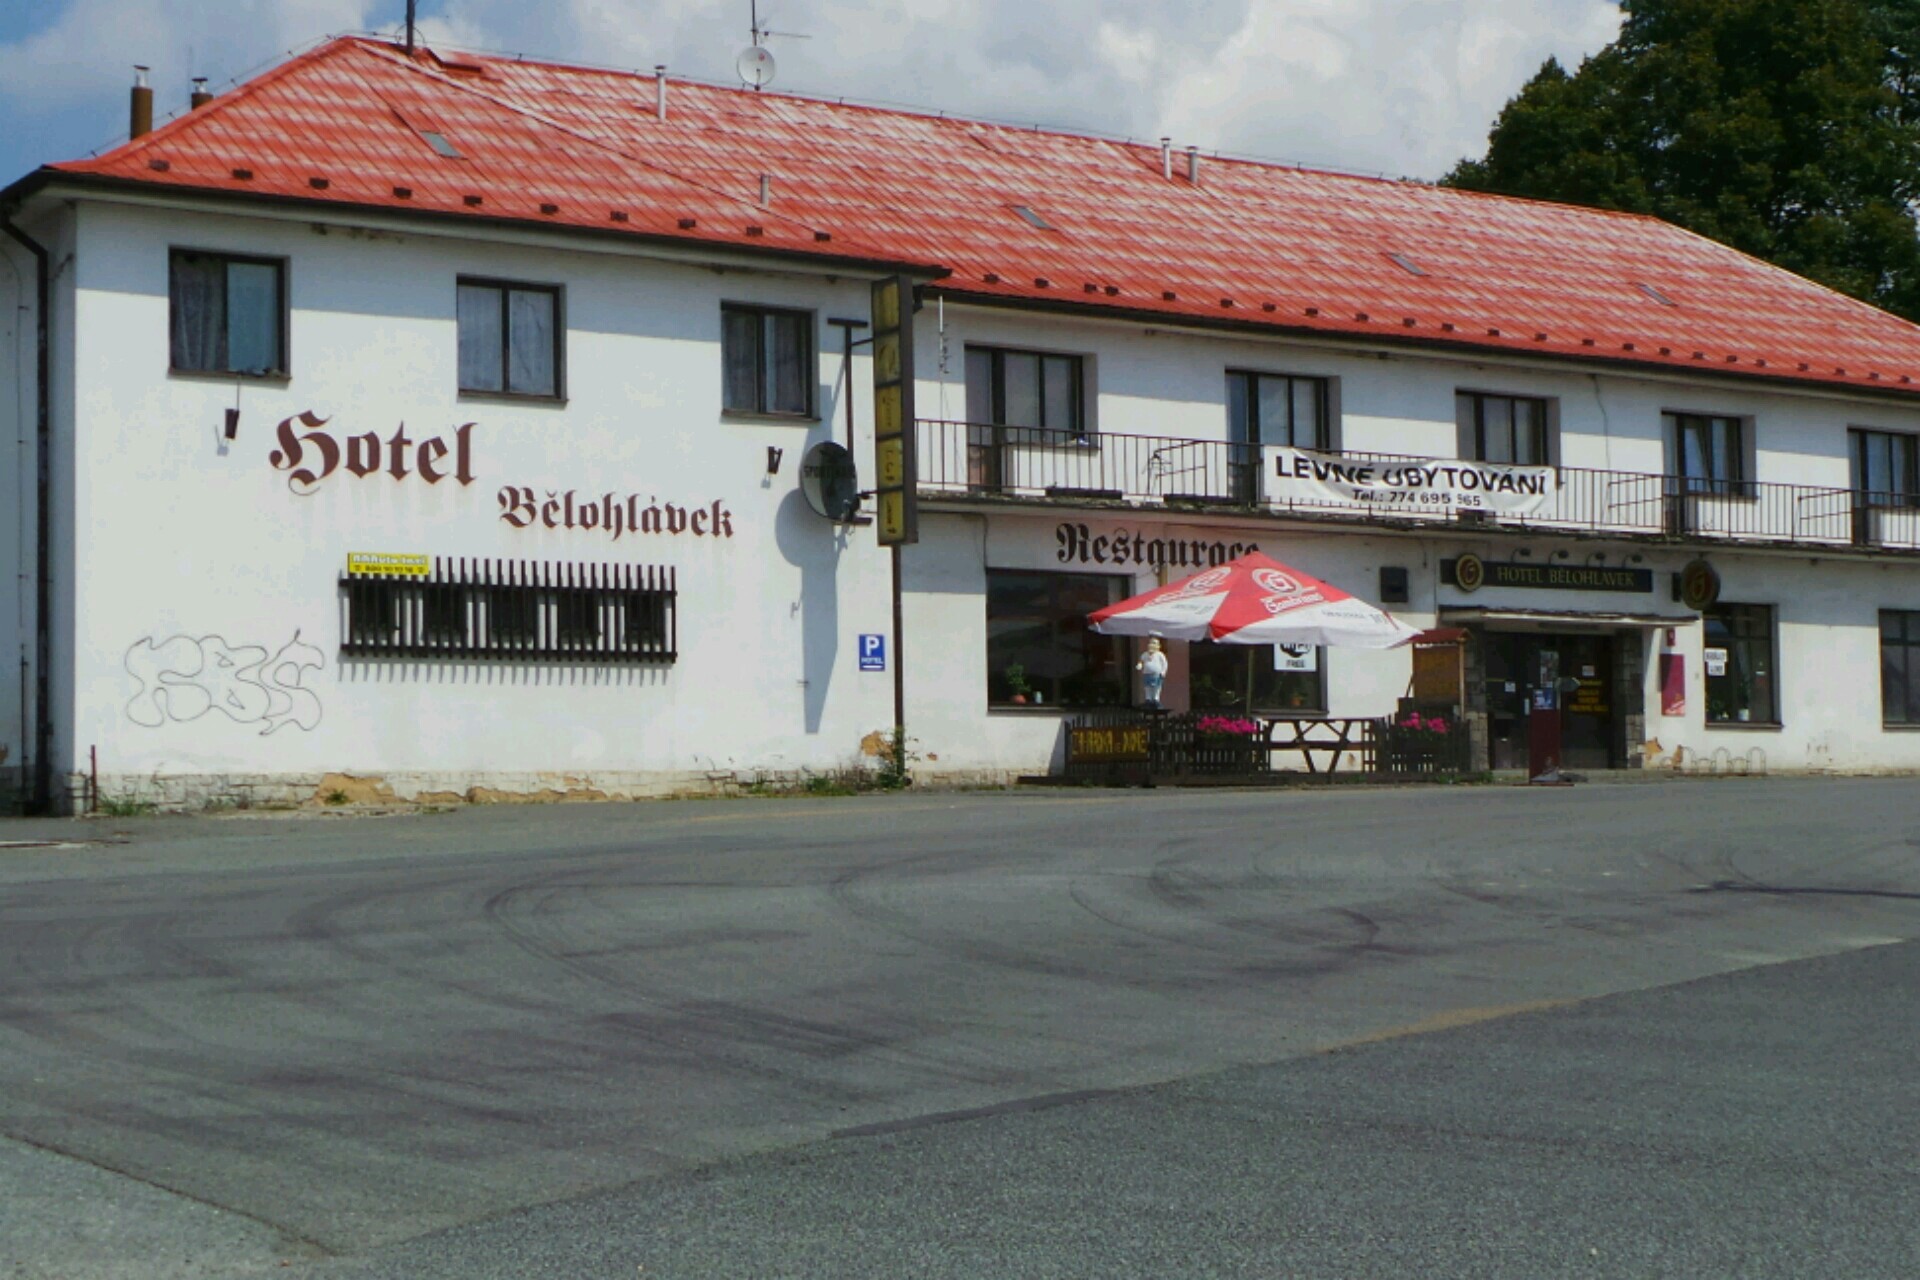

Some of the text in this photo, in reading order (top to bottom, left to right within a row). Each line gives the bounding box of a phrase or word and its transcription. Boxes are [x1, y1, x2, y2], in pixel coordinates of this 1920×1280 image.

[269, 410, 478, 496] Hotel
[1276, 456, 1545, 495] LEVNÉ UBYTOVÁNÍ
[1389, 491, 1415, 503] 774
[1421, 492, 1451, 505] 695
[497, 485, 733, 541] Bělohlávek
[1497, 566, 1543, 583] HOTEL
[865, 636, 880, 656] P
